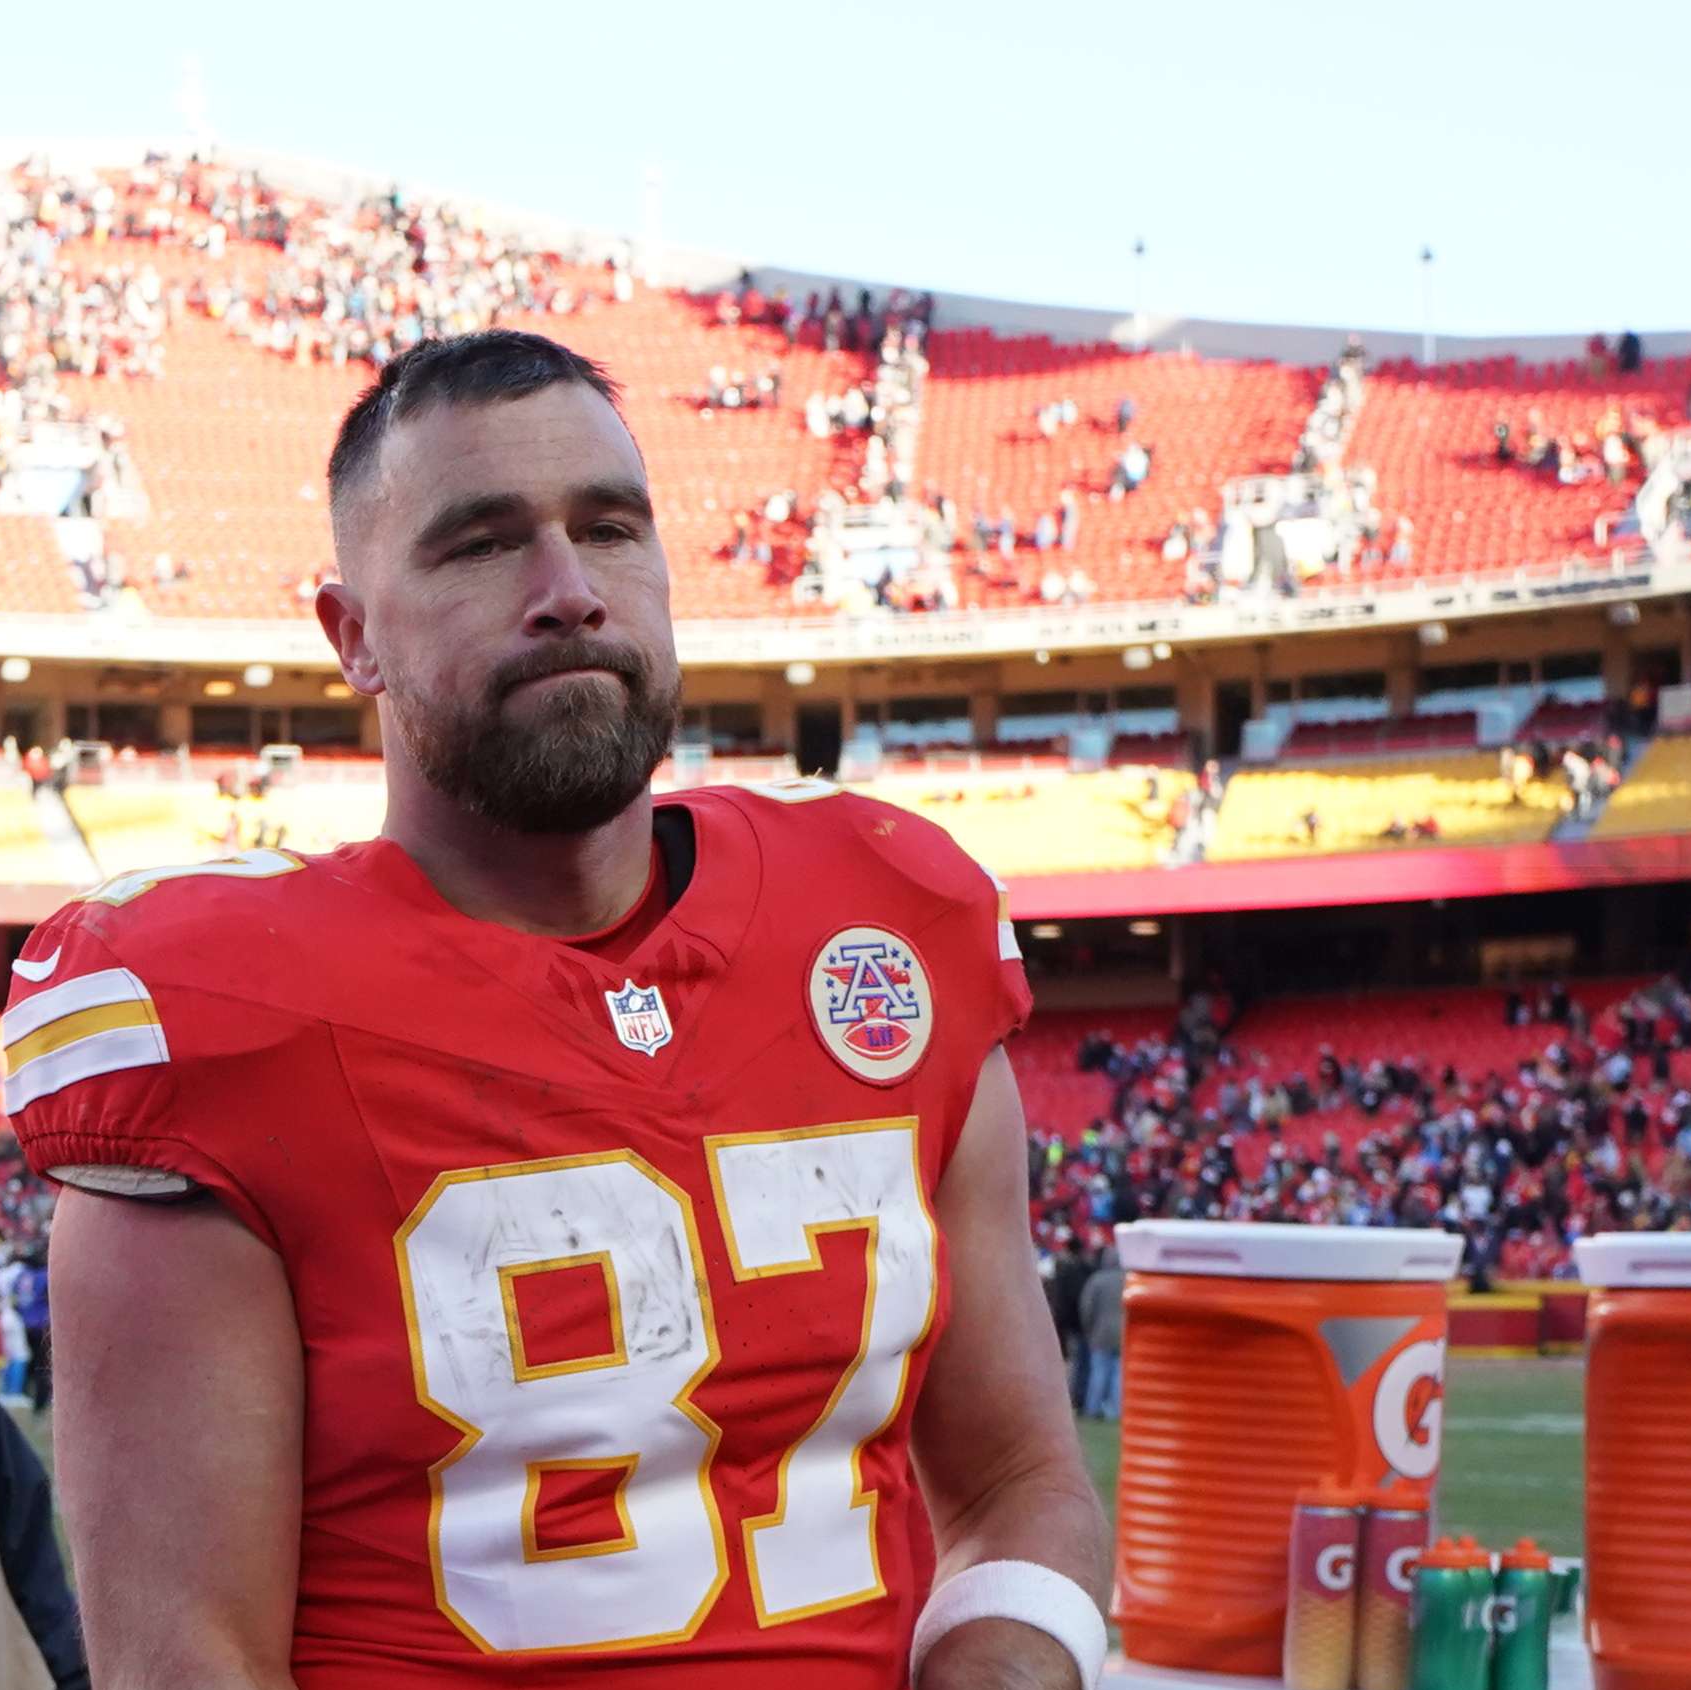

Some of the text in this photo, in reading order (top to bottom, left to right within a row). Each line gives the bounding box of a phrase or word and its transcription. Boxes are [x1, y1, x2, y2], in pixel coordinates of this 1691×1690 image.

[623, 1012, 663, 1041] NFL
[393, 1115, 938, 1653] 87
[1372, 1338, 1447, 1480] G
[1315, 1545, 1354, 1591] G
